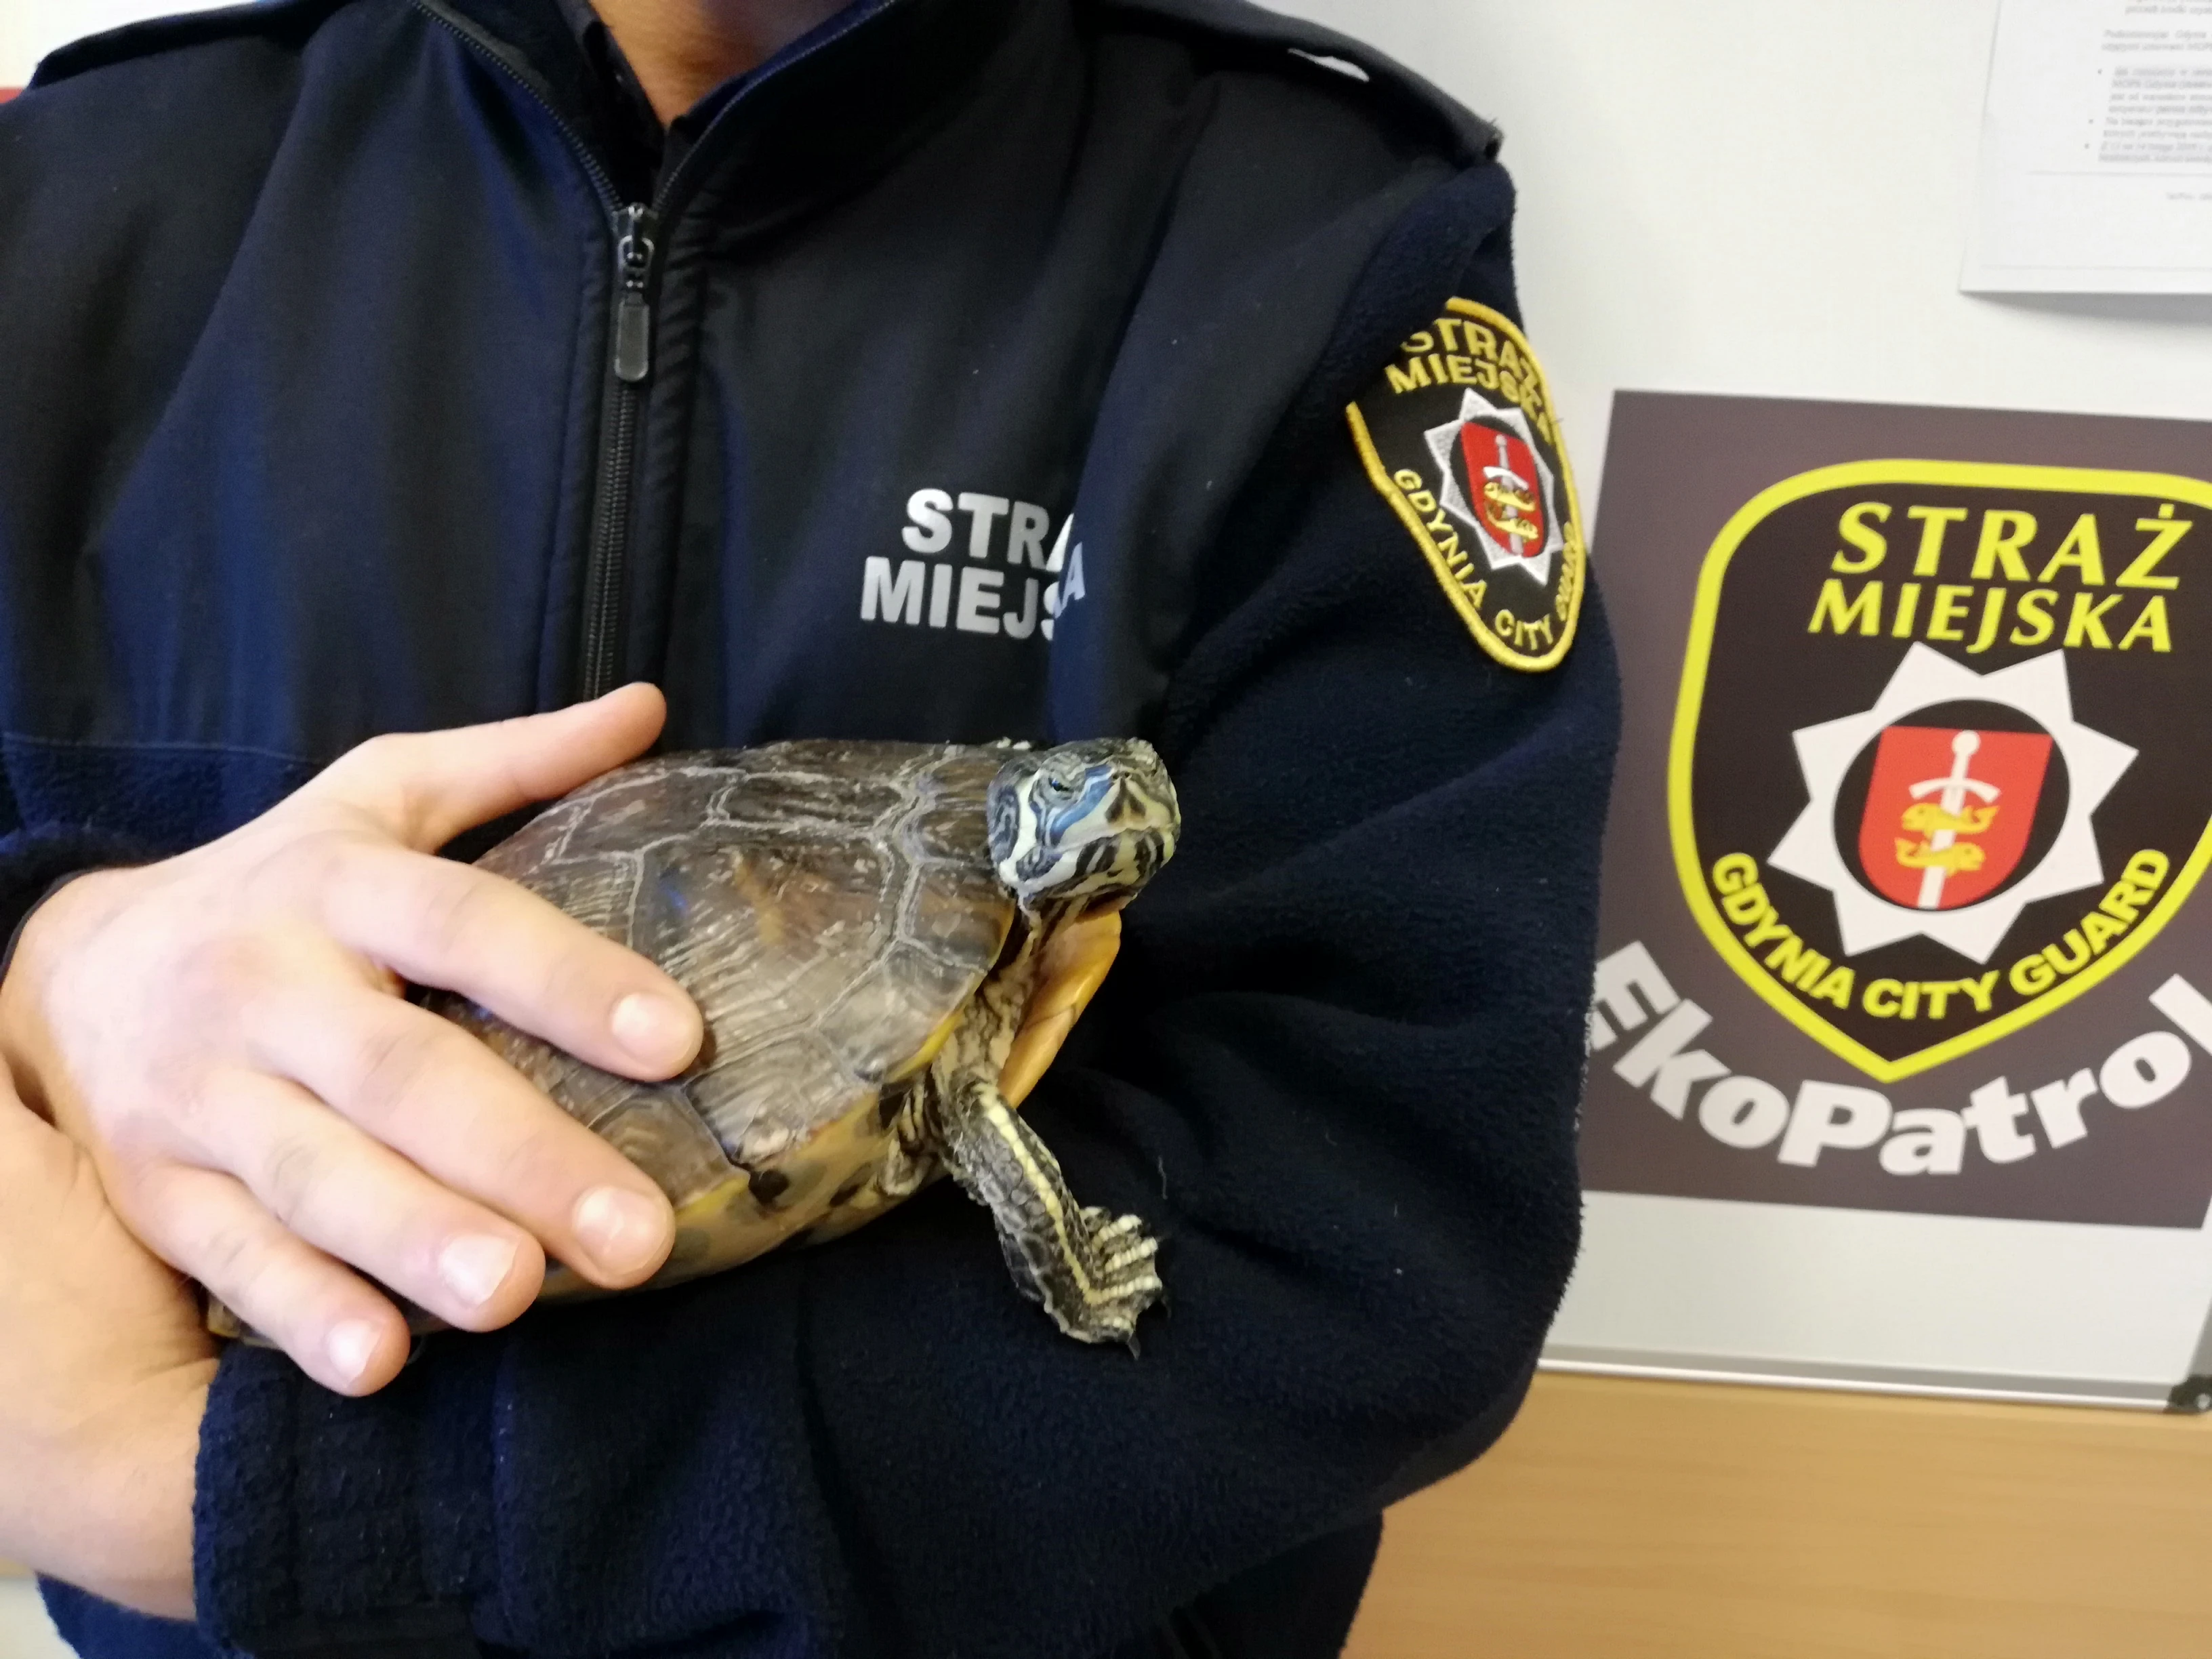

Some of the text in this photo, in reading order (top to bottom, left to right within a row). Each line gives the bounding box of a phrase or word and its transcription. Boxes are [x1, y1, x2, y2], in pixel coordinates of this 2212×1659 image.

[1395, 469, 1553, 650] GDYNIA CITY
[1831, 503, 2193, 590] STRAŻ
[1807, 578, 2172, 654] MIEJSKA
[1712, 848, 2169, 1019] GDYNIA CITY GUARD
